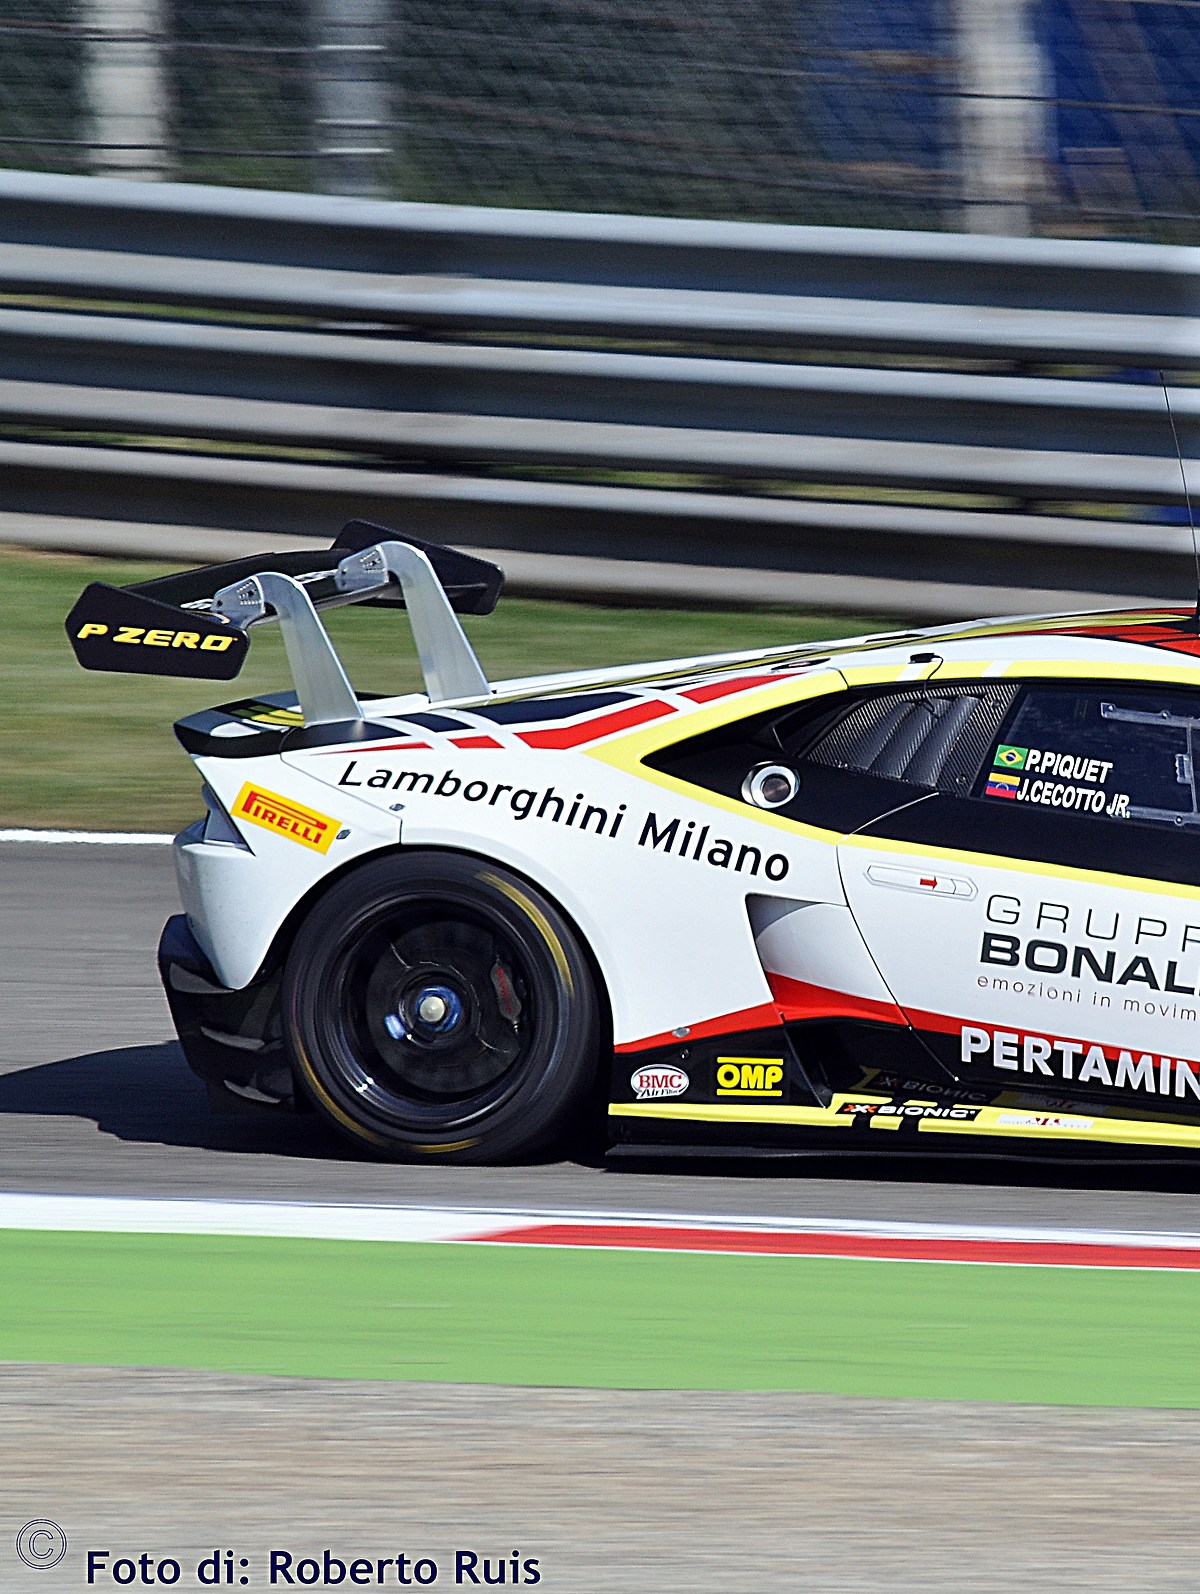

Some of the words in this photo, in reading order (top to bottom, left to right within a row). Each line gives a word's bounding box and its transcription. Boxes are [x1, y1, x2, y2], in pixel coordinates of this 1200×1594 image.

[76, 623, 109, 639] P
[112, 626, 235, 652] ZERO
[1024, 748, 1114, 784] P.PIQUET
[1016, 778, 1106, 814] J.CECOTTO
[1105, 793, 1131, 819] JR.
[241, 790, 328, 844] PIRELLI
[337, 759, 628, 839] Lamborghini
[636, 810, 791, 882] Milano
[976, 974, 1082, 1003] emozioni
[1092, 989, 1112, 1007] in
[638, 1074, 683, 1089] BMC
[716, 1062, 783, 1091] OMP
